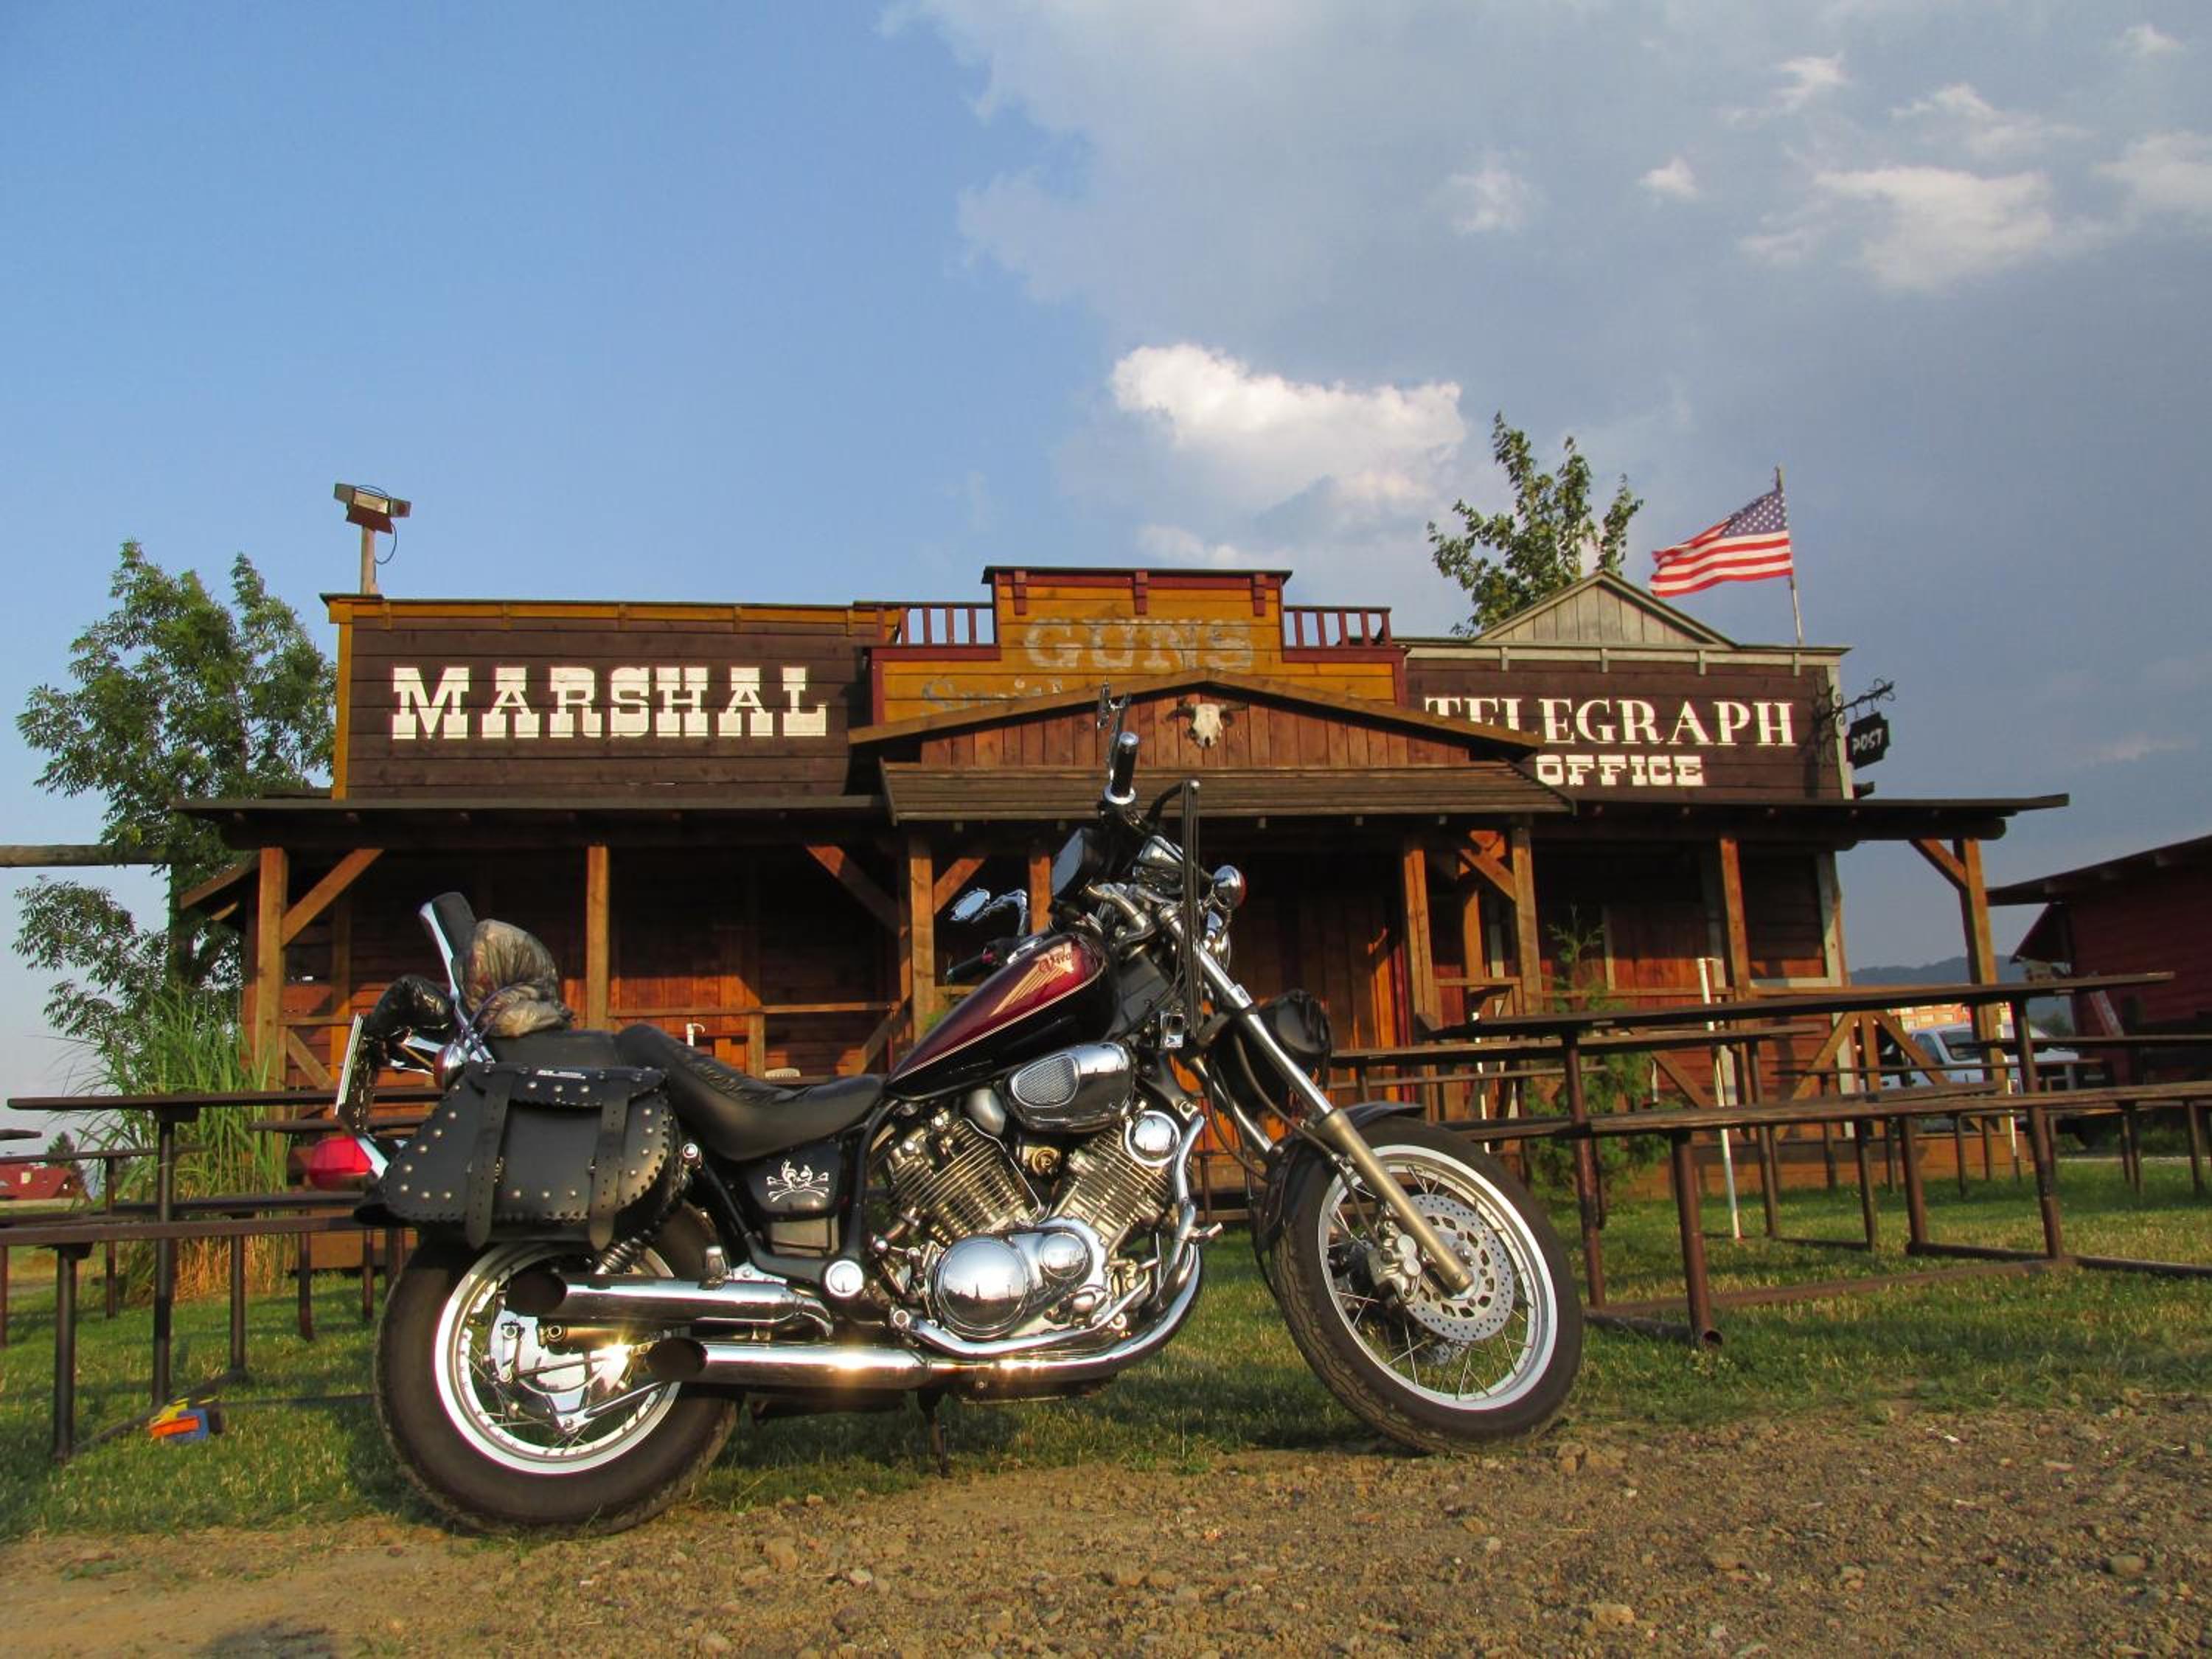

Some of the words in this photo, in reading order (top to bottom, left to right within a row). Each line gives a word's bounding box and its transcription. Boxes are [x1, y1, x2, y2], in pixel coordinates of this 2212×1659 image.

[1024, 618, 1252, 669] GUNS
[392, 667, 827, 739] MARSHAL
[1851, 728, 1883, 755] POST
[1536, 754, 1705, 787] OFFICE
